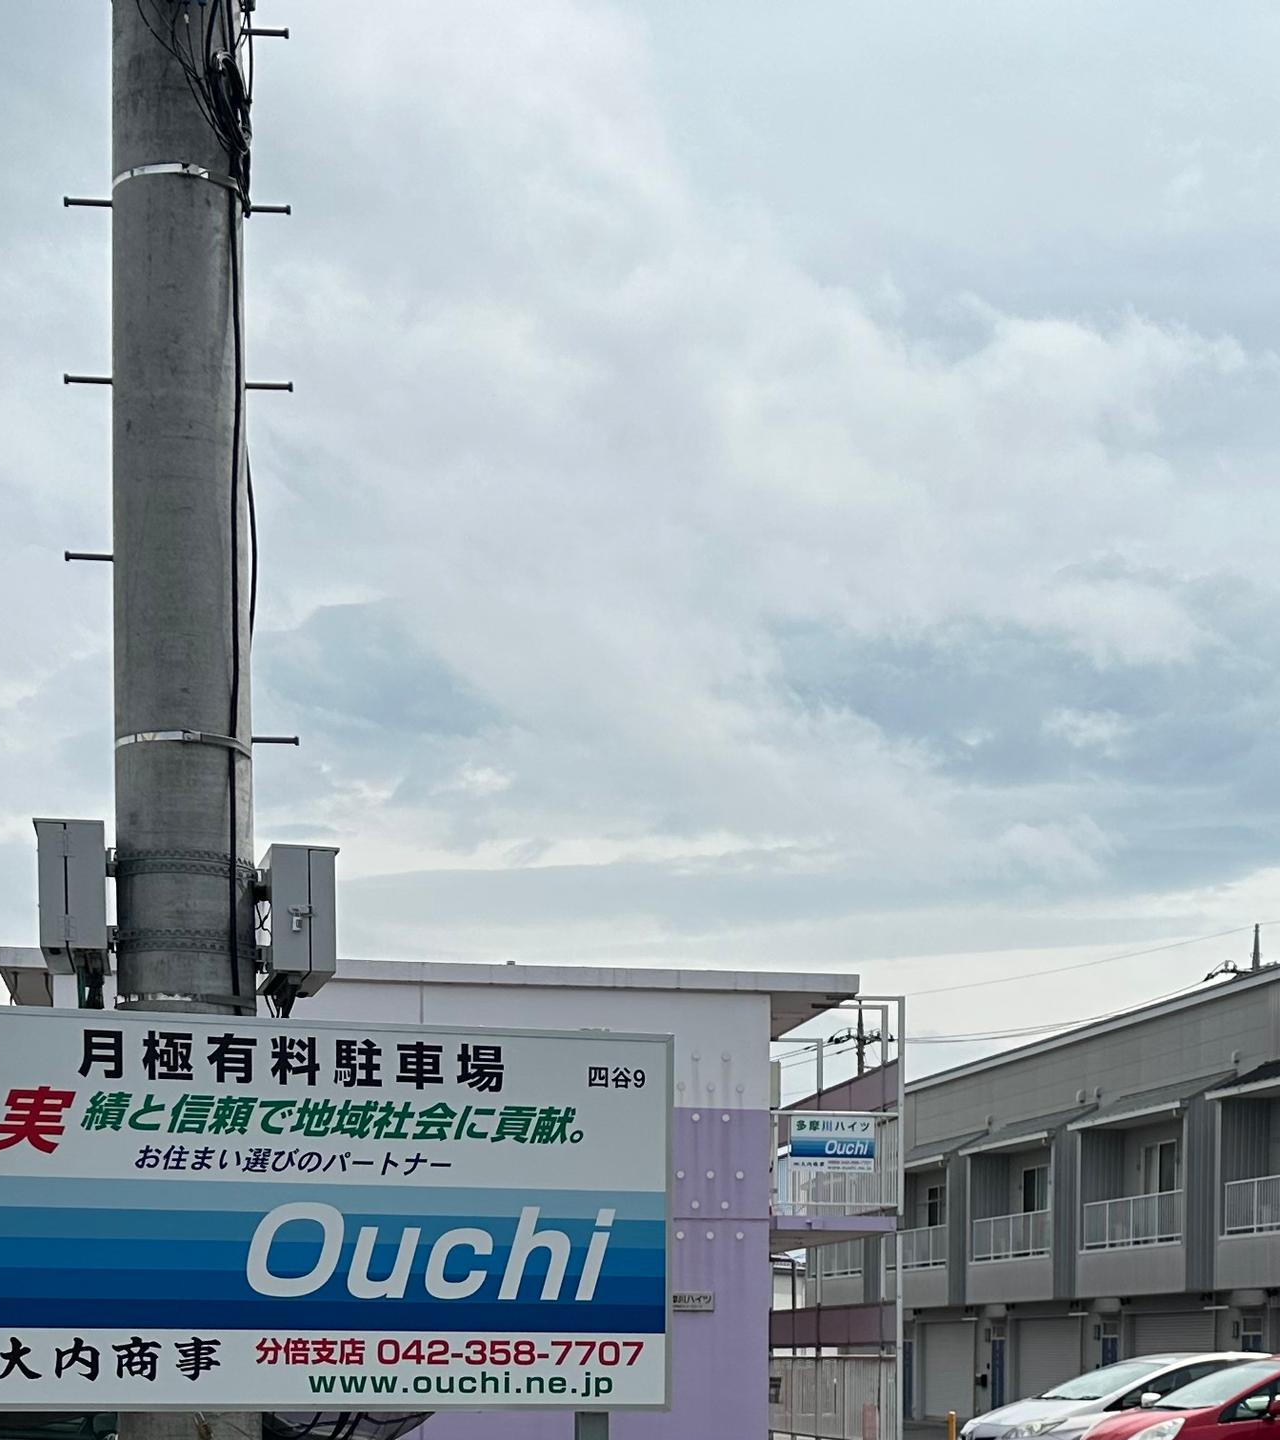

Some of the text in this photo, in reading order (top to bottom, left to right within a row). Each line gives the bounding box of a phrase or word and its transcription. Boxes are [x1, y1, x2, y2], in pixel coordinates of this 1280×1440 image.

[78, 1029, 504, 1092] 月極有料駐車場
[588, 1066, 646, 1089] 四谷9
[796, 1120, 870, 1132] 多摩川ハイツ
[135, 1145, 452, 1176] お住まい選びのパートナー
[825, 1140, 869, 1155] Ouchi
[246, 1201, 615, 1302] Ouchi
[255, 1338, 644, 1366] 分倍支店 042-358-7707
[308, 1371, 613, 1397] www.ouchi.ne.jp
